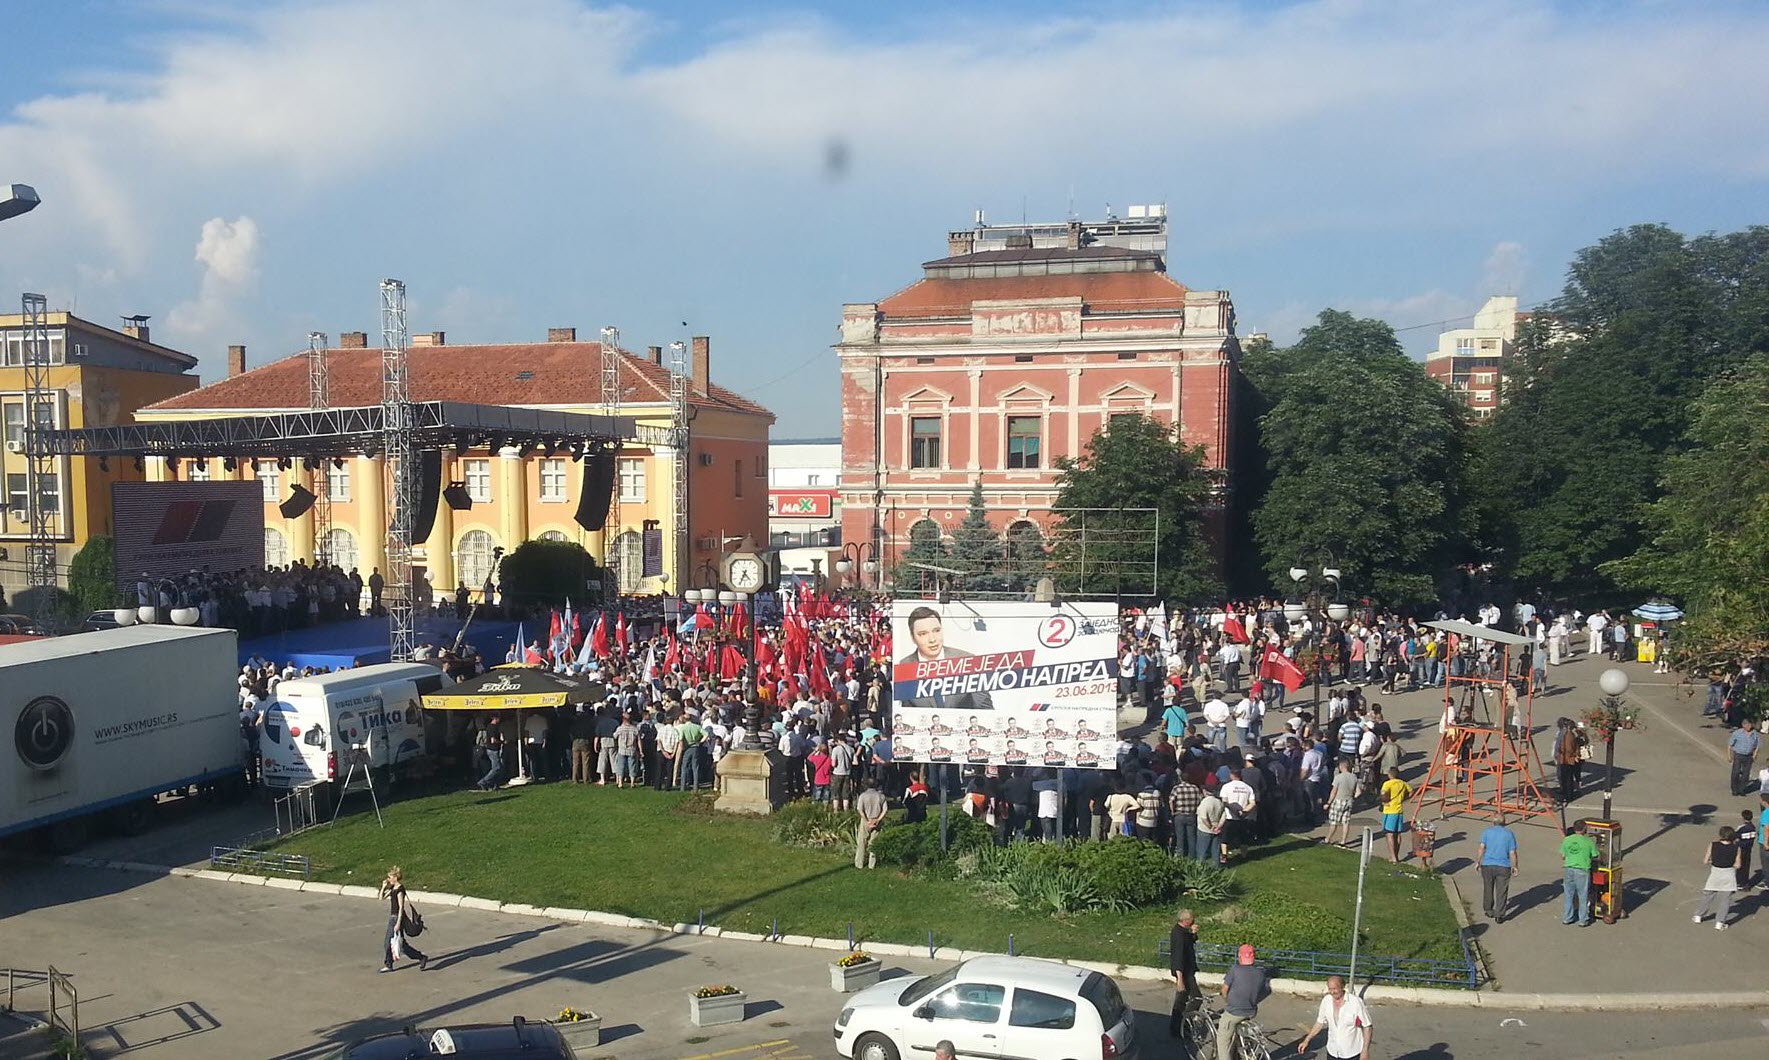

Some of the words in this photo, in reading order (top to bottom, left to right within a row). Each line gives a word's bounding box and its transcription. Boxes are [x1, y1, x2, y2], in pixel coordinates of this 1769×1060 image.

[916, 658, 972, 678] ВРЕМЕ
[996, 652, 1025, 671] ДА
[916, 670, 1018, 699] КРЕНЕМО
[1020, 660, 1109, 687] НАПРЕД
